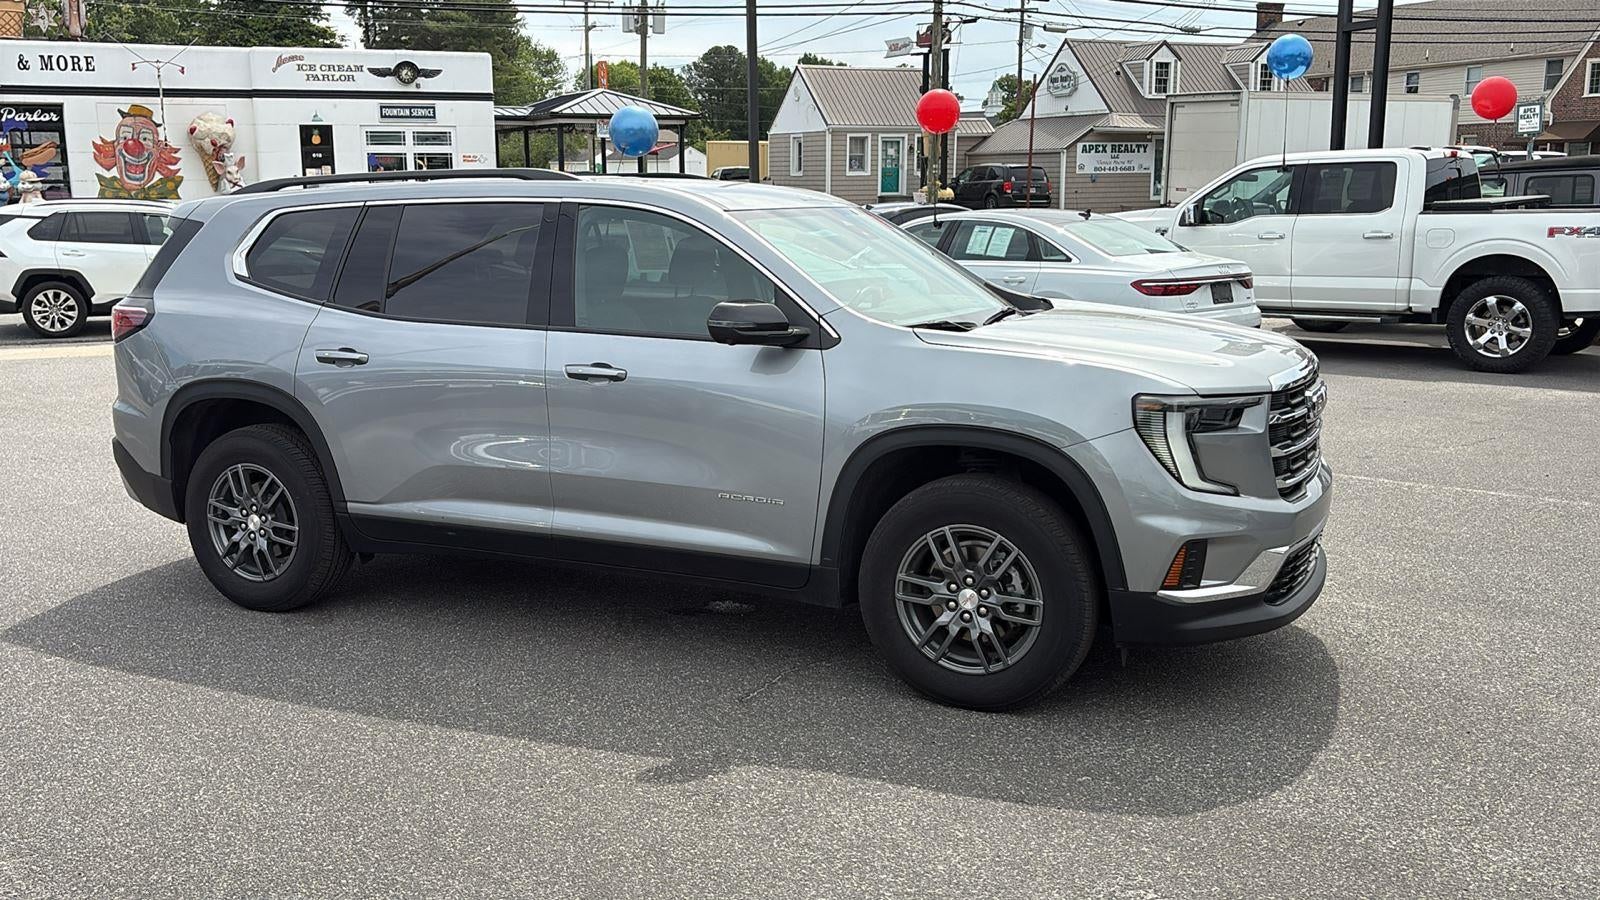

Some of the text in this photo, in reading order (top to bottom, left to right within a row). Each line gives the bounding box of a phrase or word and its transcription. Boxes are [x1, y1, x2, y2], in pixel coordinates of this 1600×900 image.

[17, 53, 96, 72] & MORE
[296, 63, 364, 73] ICE CREAM
[305, 73, 356, 82] PARLOR
[0, 106, 60, 122] Parlor
[382, 107, 434, 117] FOUNTAIN SERVICE
[1081, 143, 1149, 154] APEX REALTY
[718, 492, 785, 505] ACADIA
